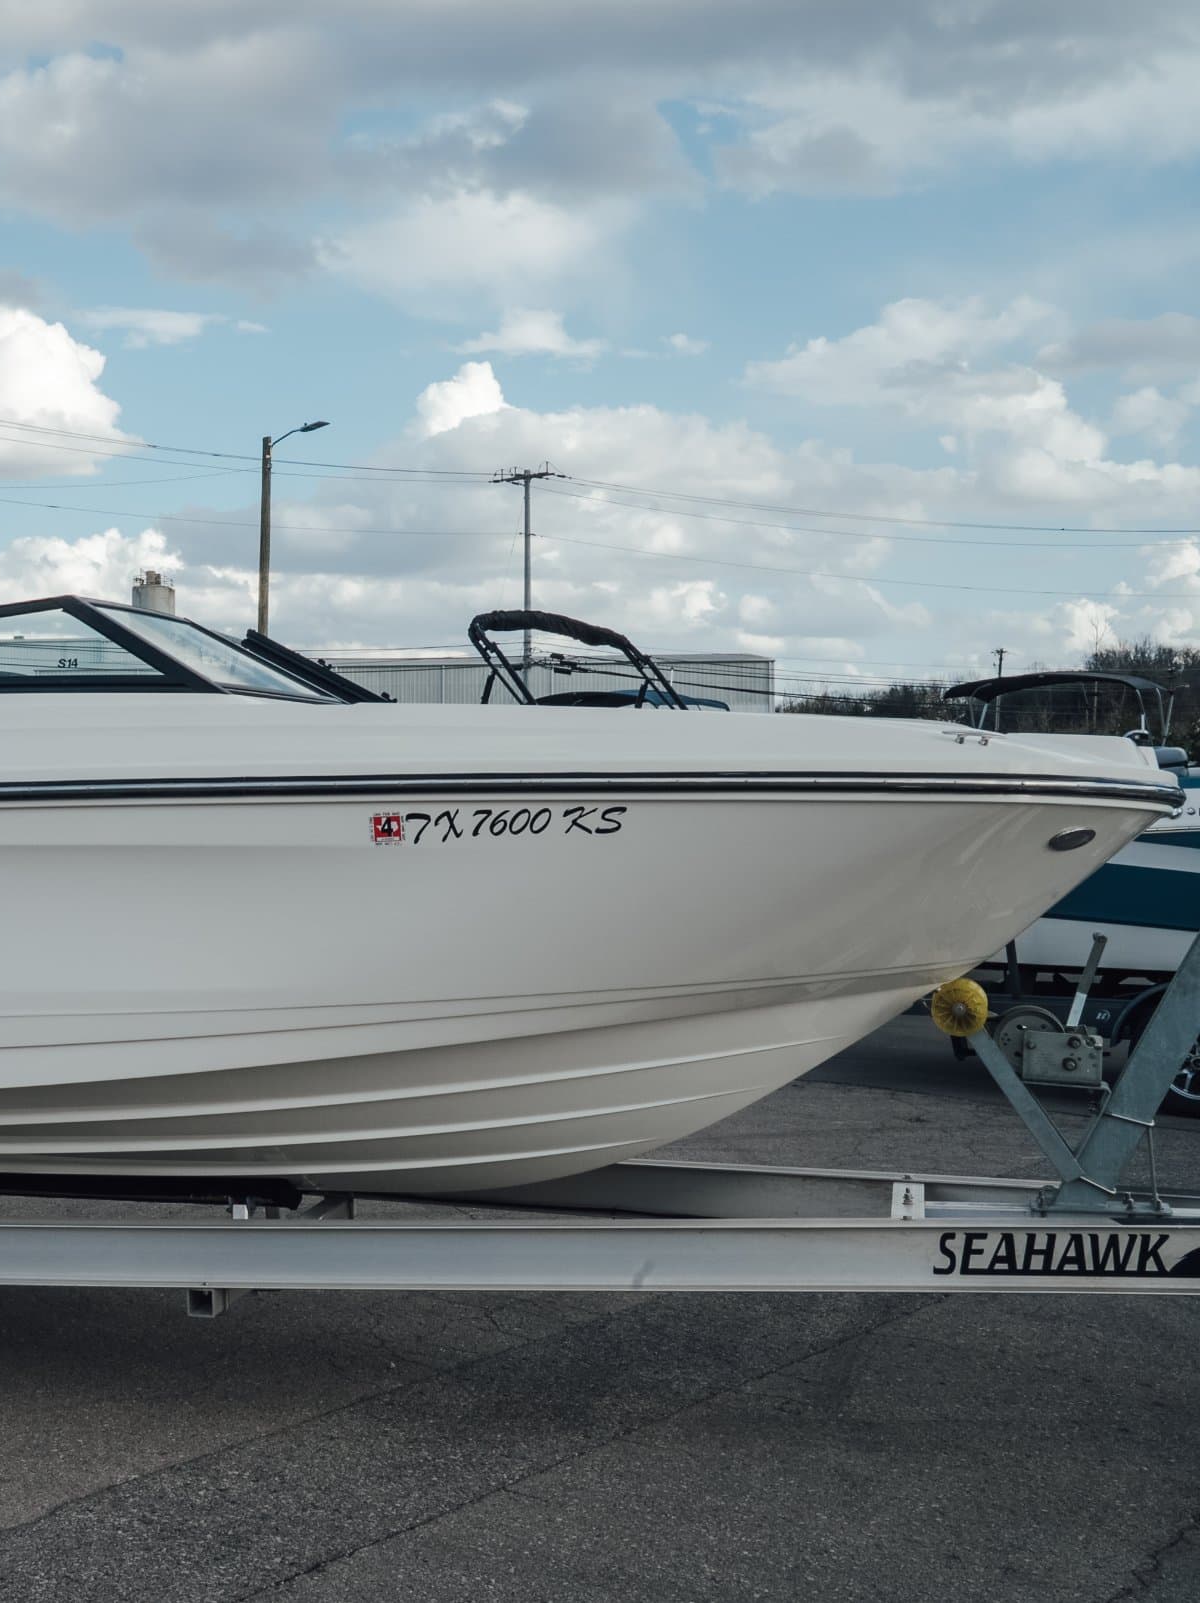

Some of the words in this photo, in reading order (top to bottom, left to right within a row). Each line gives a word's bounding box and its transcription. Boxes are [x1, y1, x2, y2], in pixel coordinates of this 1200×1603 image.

[57, 658, 78, 668] S14
[381, 816, 394, 837] 4
[472, 808, 551, 836] 7600
[563, 806, 627, 835] KS
[933, 1232, 1170, 1277] SEAHAWK
